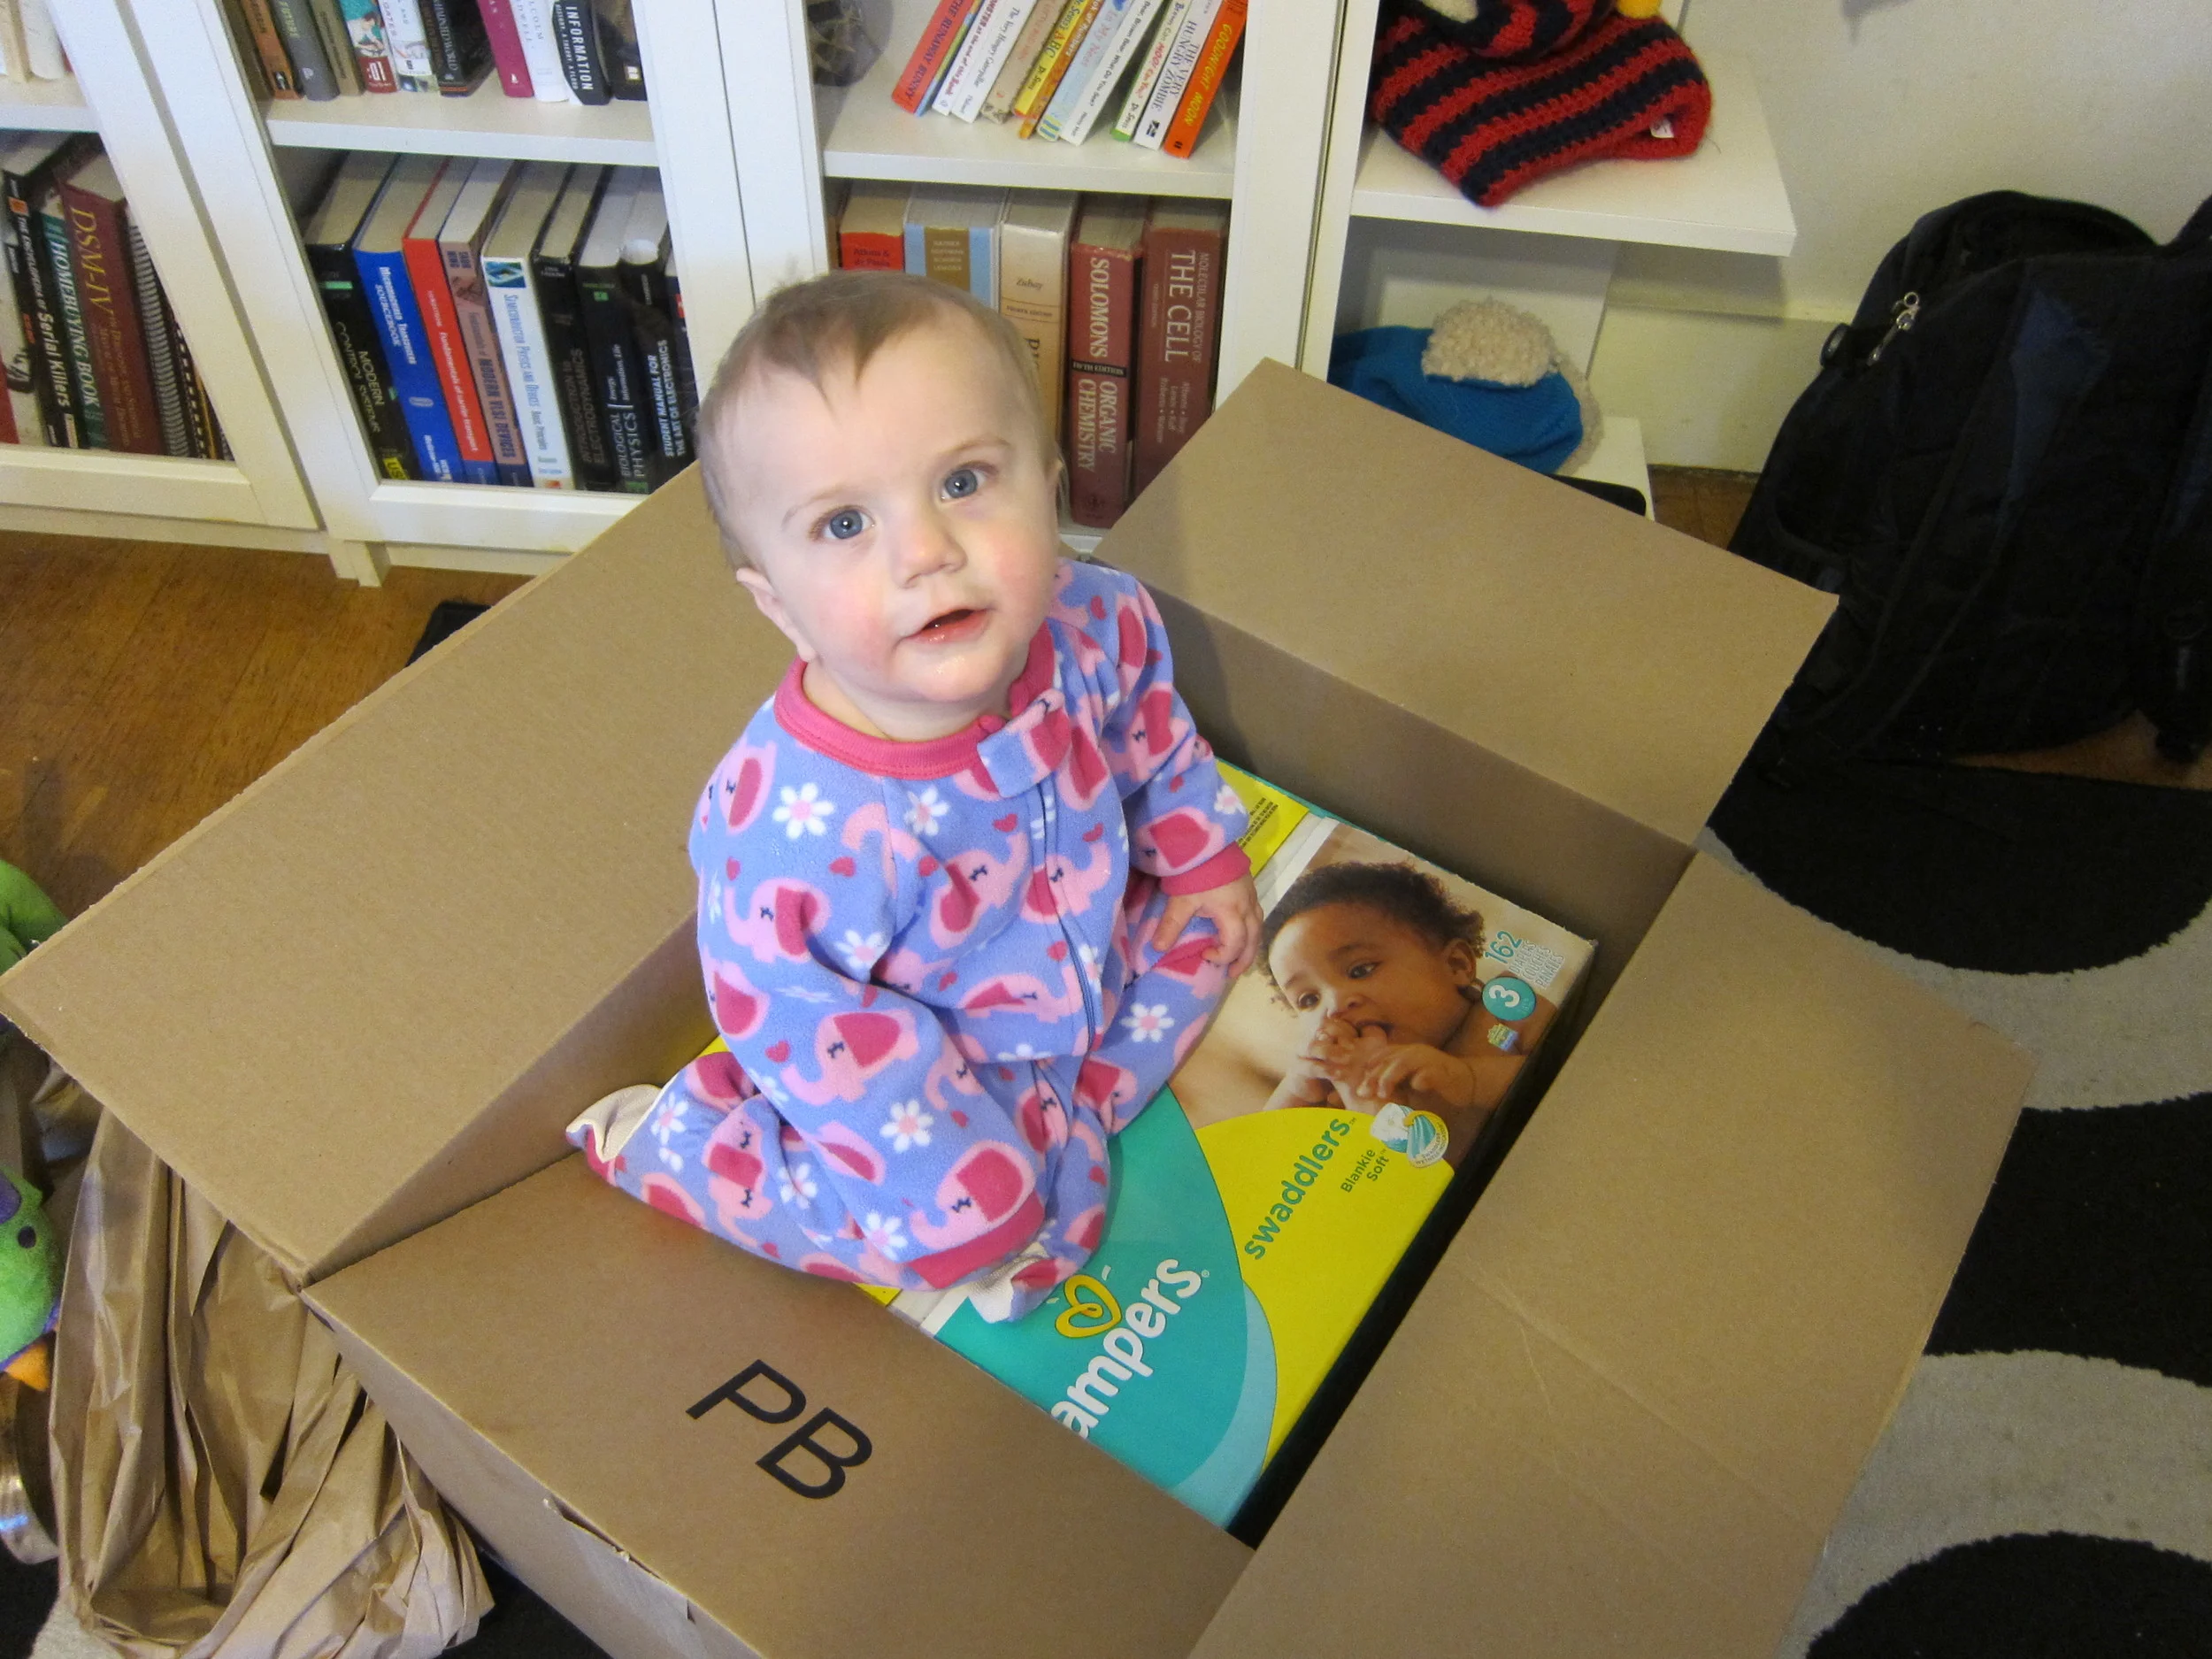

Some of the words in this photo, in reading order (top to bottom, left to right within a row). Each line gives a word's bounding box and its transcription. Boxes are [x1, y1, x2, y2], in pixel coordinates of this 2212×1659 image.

[1000, 19, 1013, 34] Very
[1009, 6, 1020, 19] The
[1126, 17, 1141, 38] Brown
[1166, 2, 1185, 27] Brown
[565, 6, 594, 90] INFORMATION
[923, 16, 953, 64] RUNAWAY
[988, 33, 1007, 58] Hungry
[1044, 30, 1065, 58] ABC
[1093, 22, 1111, 43] My
[1159, 26, 1172, 42] Can
[1170, 19, 1197, 68] HUNGRY
[973, 56, 995, 88] Caterpillar
[1108, 53, 1121, 71] What
[1182, 42, 1200, 66] THE
[1199, 23, 1234, 91] GOODNIGHT
[904, 64, 926, 99] BUNNY
[1028, 75, 1041, 90] Seuss
[1096, 80, 1107, 91] You
[1143, 67, 1154, 82] Can
[1151, 68, 1176, 112] ZOMBIE
[1169, 67, 1188, 97] VERY
[1087, 91, 1100, 107] See?
[1183, 91, 1204, 127] MOON
[1121, 112, 1135, 129] Seuss
[70, 207, 114, 314] DSM-IV
[1169, 250, 1195, 298] THE
[1197, 252, 1209, 308] MOLECULAR
[22, 234, 43, 296] ENCYCLOPEDIA
[37, 312, 61, 356] Serial
[50, 359, 71, 406] Killers
[50, 242, 88, 356] HOMEBUYING
[78, 361, 99, 407] BOOK
[375, 284, 402, 346] SOURCEBOOK
[1088, 257, 1110, 358] SOLOMONS
[1165, 304, 1192, 361] CELL
[1193, 310, 1204, 348] BIOLOGY
[646, 355, 659, 373] FOR
[657, 339, 676, 403] ELECTRONICS
[1192, 350, 1202, 363] OF
[334, 322, 363, 379] CONTROL
[359, 383, 380, 433] SYSTEMS
[359, 350, 386, 405] MODERN
[439, 331, 460, 384] Fundamentals
[463, 418, 480, 451] transport
[479, 358, 501, 397] MODERN
[490, 398, 505, 419] VLSI
[568, 348, 604, 464] ELECTRODYNAMICS
[650, 377, 666, 415] MANUAL
[670, 419, 681, 436] ART
[1078, 379, 1097, 473] CHEMISTRY
[1100, 380, 1118, 454] ORGANIC
[495, 422, 517, 458] DEVICES
[609, 412, 630, 476] BIOLOGICAL
[623, 411, 644, 479] PHYSICS
[657, 418, 673, 457] STUDENT
[674, 439, 685, 456] THE
[1485, 931, 1523, 964] 162
[1509, 940, 1537, 973] DIAPERS
[1522, 947, 1552, 981] COUCHES
[1488, 984, 1520, 1008] 3
[1340, 1149, 1375, 1193] Blankie
[1366, 1155, 1389, 1182] Soft
[685, 1359, 872, 1500] PB
